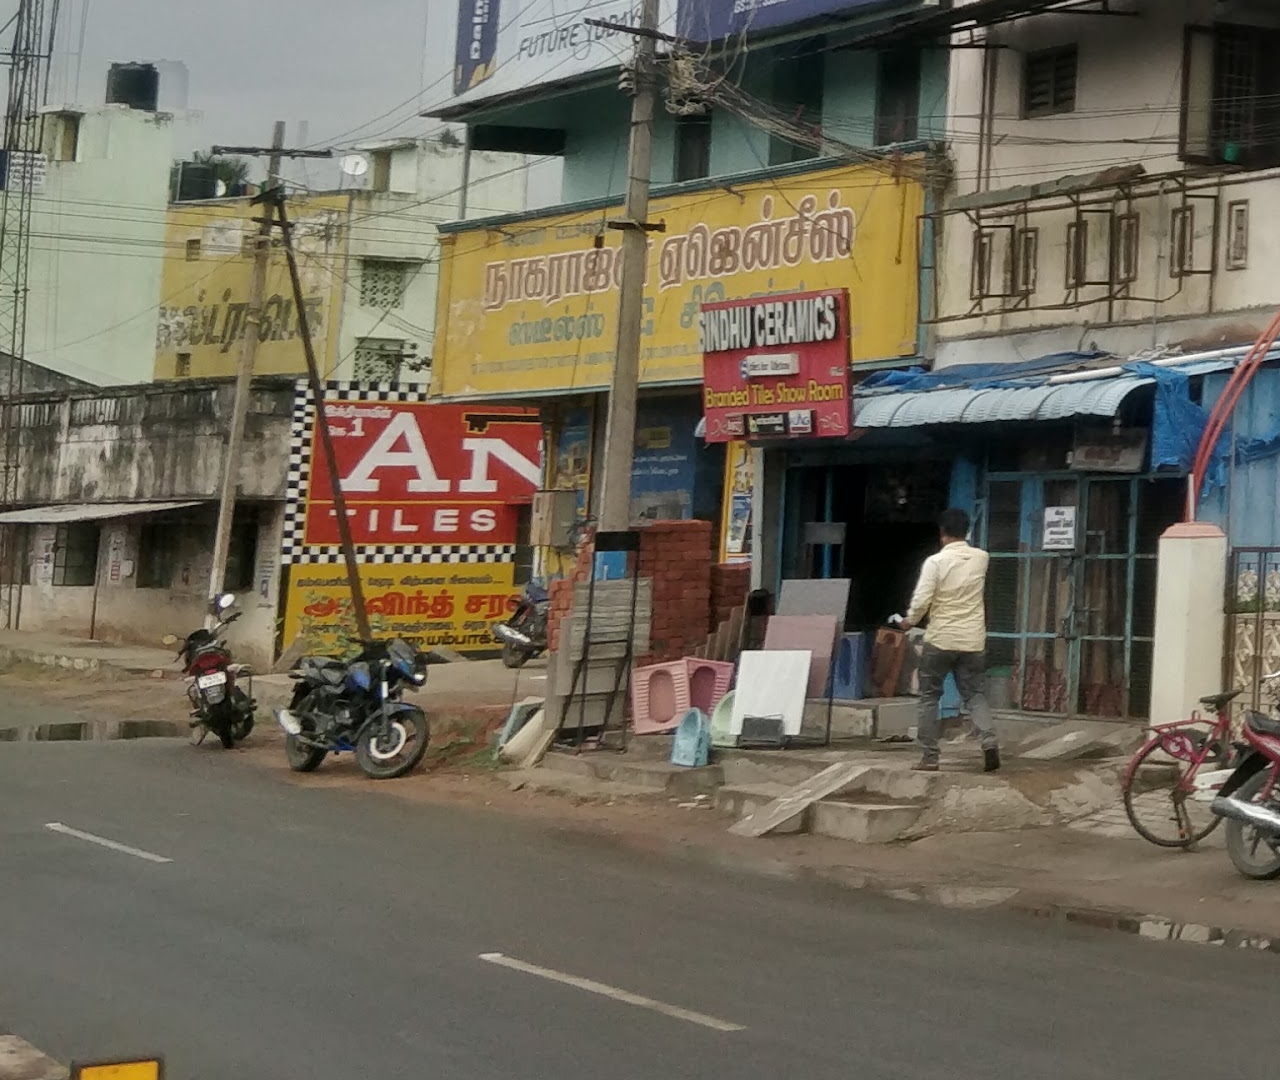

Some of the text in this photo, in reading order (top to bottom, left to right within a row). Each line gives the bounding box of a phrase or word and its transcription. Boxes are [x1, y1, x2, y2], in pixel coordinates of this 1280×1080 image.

[517, 22, 585, 61] FUTURE
[659, 189, 858, 292] ஏஜென்சீஸ்
[699, 305, 752, 353] SINDHU
[754, 295, 836, 347] CERAMICS
[705, 379, 844, 409] Branded Tiles Show Room
[304, 589, 454, 619] அவிந்த்
